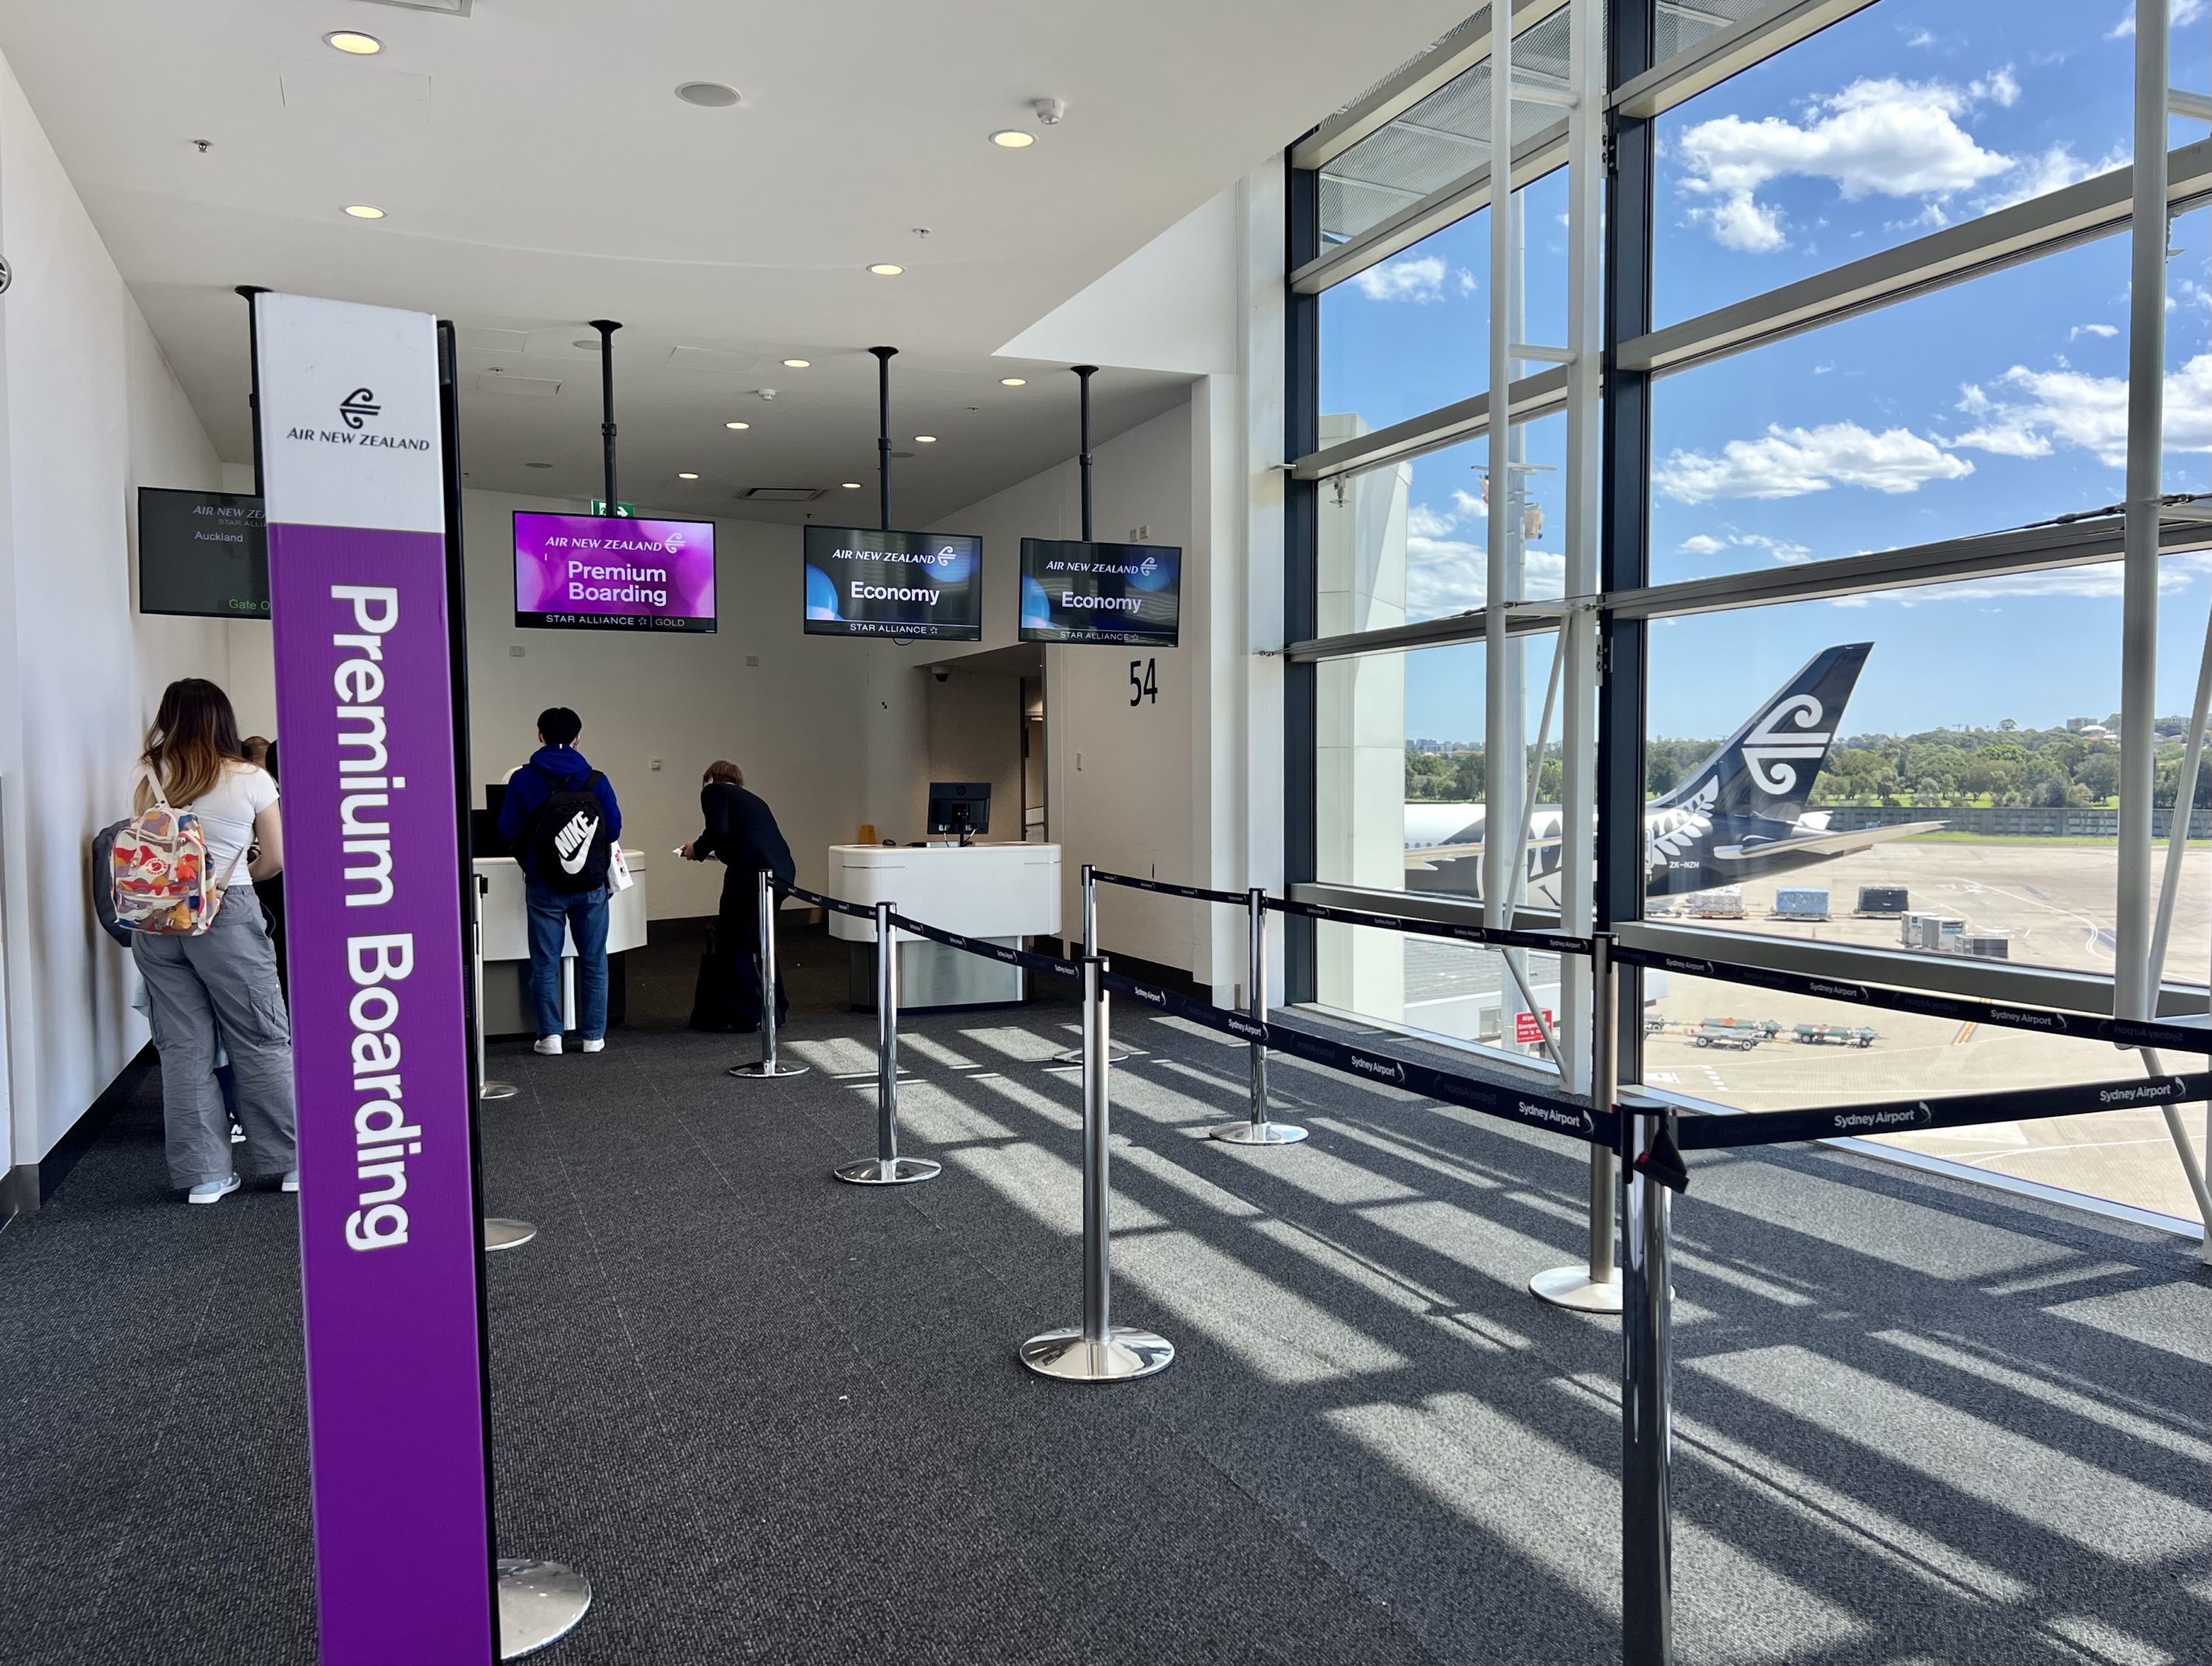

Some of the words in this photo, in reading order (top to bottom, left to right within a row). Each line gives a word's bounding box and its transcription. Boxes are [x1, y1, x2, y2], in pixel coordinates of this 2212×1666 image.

[287, 427, 314, 441] AIR
[320, 431, 356, 444] NEW
[359, 434, 430, 450] ZEALAND
[193, 506, 213, 515] AIR
[218, 507, 245, 517] NEW
[195, 531, 243, 543] Auckland
[546, 537, 568, 546] AIR
[571, 538, 602, 548] NEW
[603, 539, 662, 551] ZEALAND
[832, 549, 852, 560] AIR
[855, 551, 882, 560] NEW
[883, 552, 935, 564] ZEALAND
[568, 560, 667, 582] Premium
[1046, 560, 1064, 571] AIR
[1067, 562, 1091, 571] NEW
[1092, 563, 1138, 574] ZEALAND
[568, 582, 667, 607] Boarding
[851, 581, 940, 606] Economy
[1062, 591, 1141, 613] Economy
[229, 599, 257, 610] Gate
[546, 615, 575, 624] STAR
[579, 616, 634, 625] ALLIANCE
[655, 618, 685, 627] GOLD
[850, 623, 875, 632] STAR
[878, 624, 927, 634] ALLIANCE
[1060, 631, 1083, 639] STAR
[1085, 632, 1129, 641] ALLIANCE
[1130, 658, 1158, 707] 54
[331, 585, 406, 907] Premium
[554, 810, 594, 859] NIKE
[1669, 861, 1700, 869] ZK-NZH
[1666, 958, 1685, 969] Sydney
[1686, 961, 1705, 971] Airport
[1135, 986, 1148, 999] Sydney
[1147, 991, 1161, 1003] Airport
[1809, 982, 1833, 994] Sydney
[1833, 986, 1857, 997] Airport
[1991, 1009, 2021, 1022] Sydney
[2021, 1014, 2052, 1025] Airport
[1228, 1019, 1245, 1033] Sydney
[1245, 1023, 1262, 1036] Airport
[1351, 1055, 1373, 1072] Sydney
[1372, 1062, 1396, 1077] Airport
[346, 933, 422, 1251] Boarding
[2099, 1089, 2136, 1103] Sydney
[2135, 1084, 2171, 1098] Airport
[1519, 1101, 1549, 1121] Sydney
[1549, 1108, 1581, 1127] Airport
[1834, 1114, 1875, 1128] Sydney
[1875, 1109, 1915, 1124] Airport
